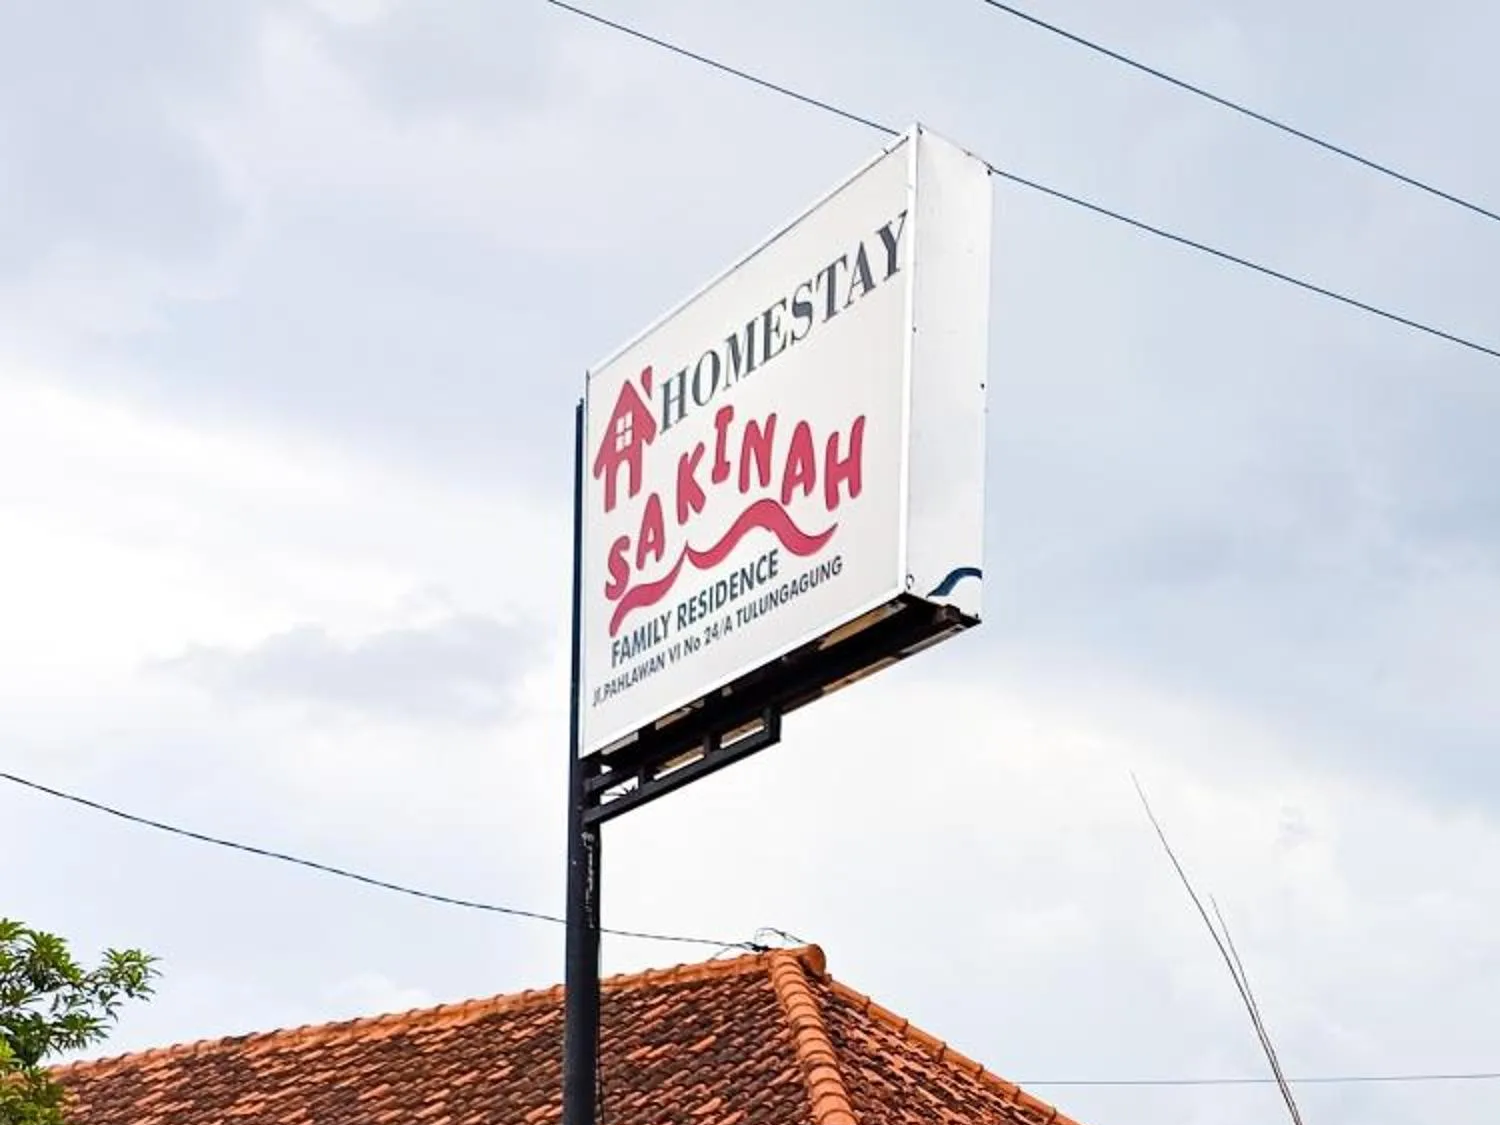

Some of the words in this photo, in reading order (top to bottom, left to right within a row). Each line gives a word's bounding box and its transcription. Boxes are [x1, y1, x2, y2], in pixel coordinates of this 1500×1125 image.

[659, 209, 908, 435] HOMESTAY
[604, 405, 865, 600] SAKINAH
[611, 610, 672, 668] FAMILY
[677, 548, 779, 632] RESIDENCE
[668, 642, 681, 664] VI
[736, 555, 843, 628] TULUNGAGUNG
